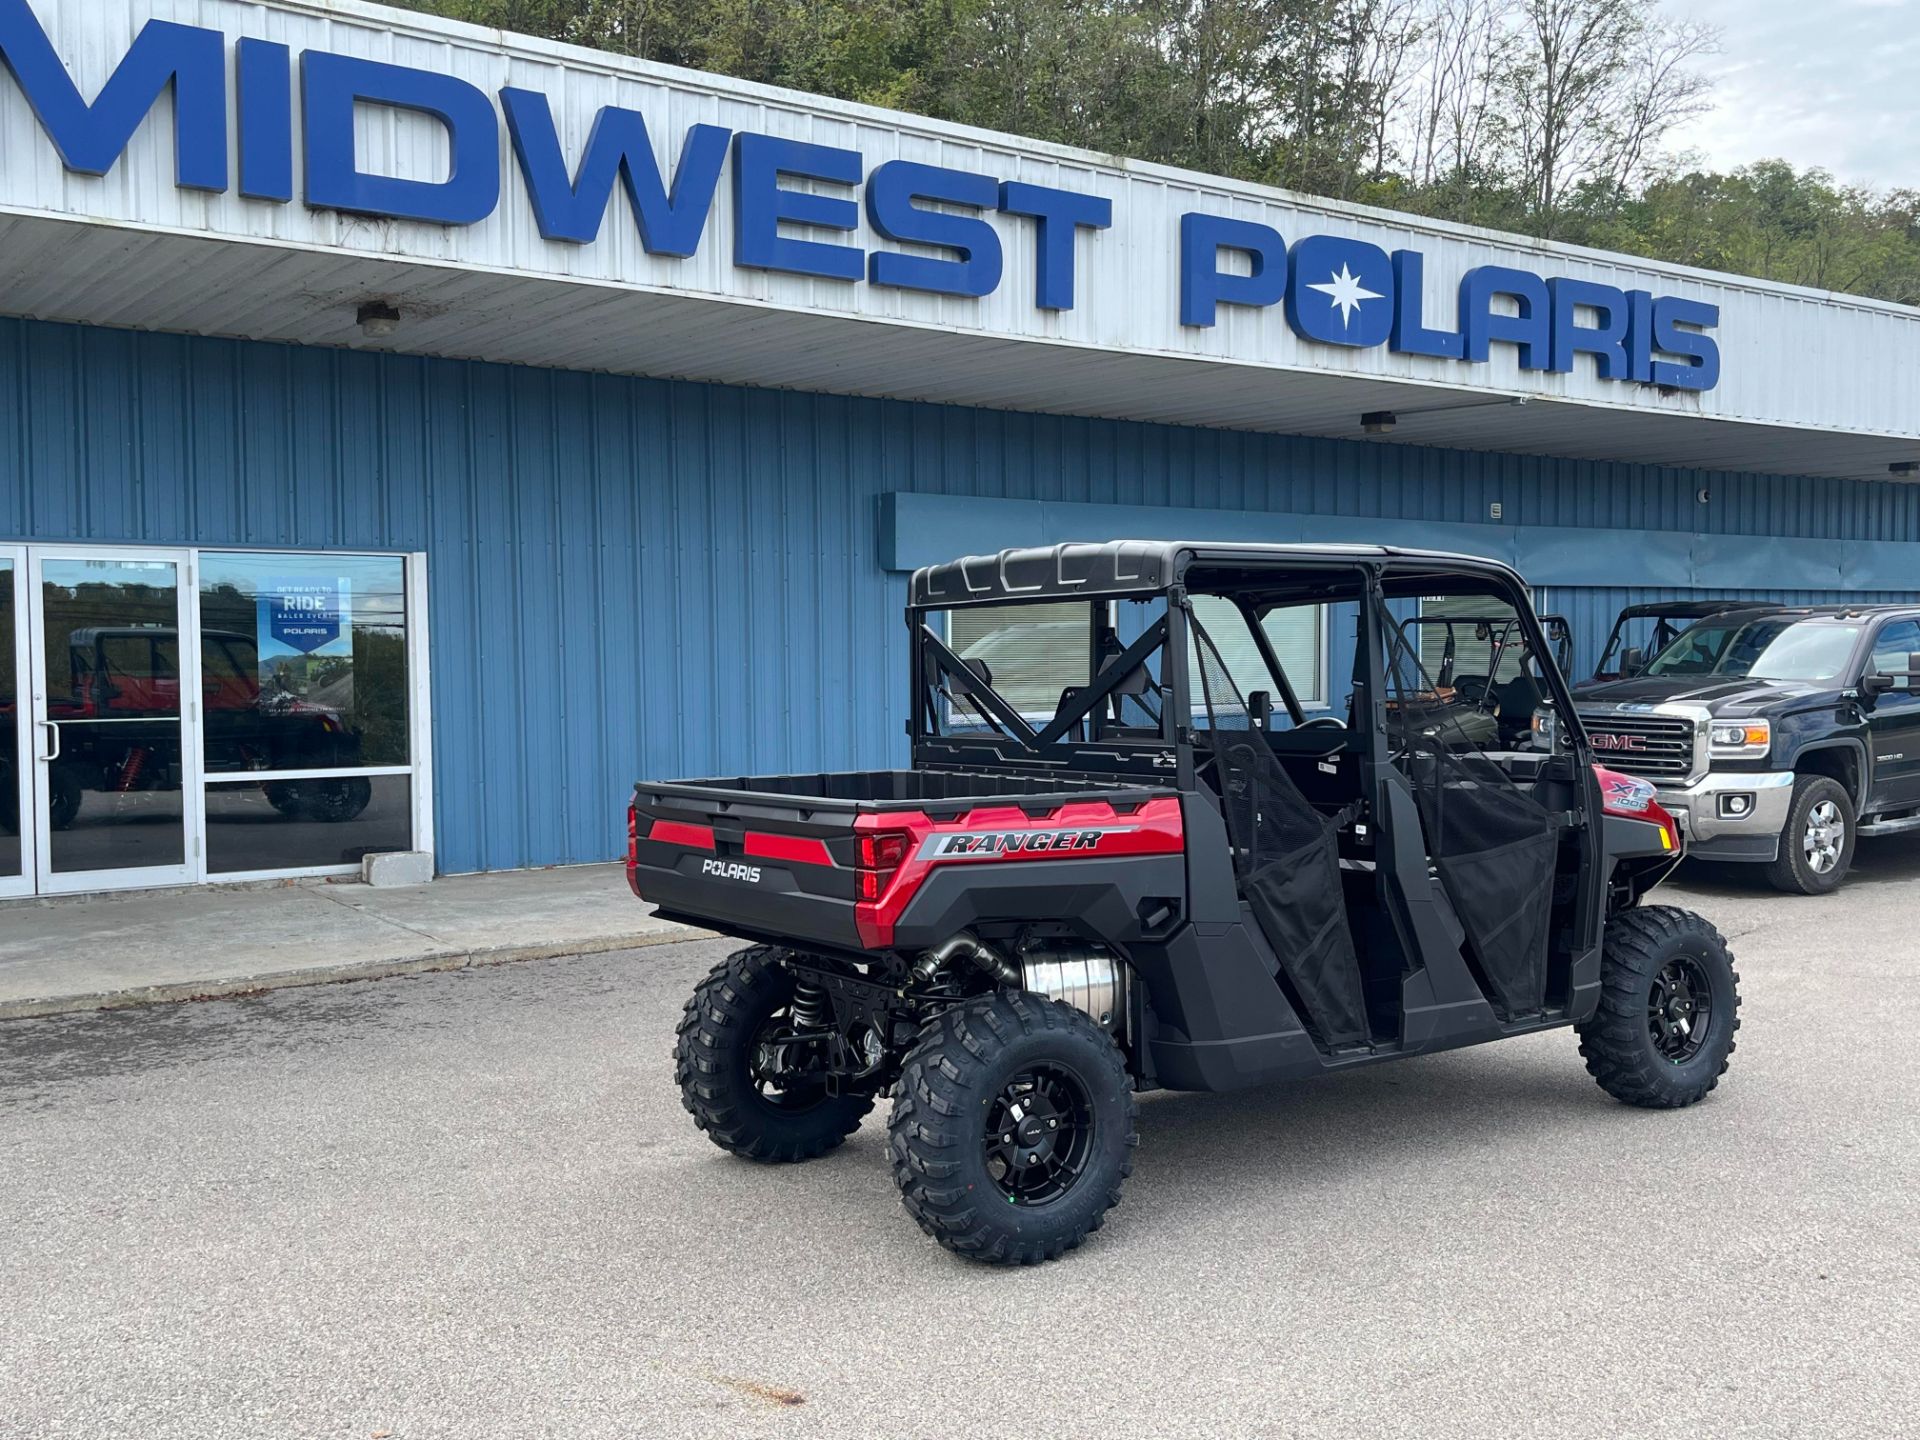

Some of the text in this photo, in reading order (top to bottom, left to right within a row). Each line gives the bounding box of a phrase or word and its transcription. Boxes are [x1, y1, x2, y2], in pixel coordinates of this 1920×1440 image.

[0, 0, 1720, 391] MIDWEST POLARIS
[283, 595, 326, 611] RIDE
[283, 627, 328, 635] POLARIS
[1589, 733, 1646, 752] GMC
[1617, 797, 1648, 809] 1000
[942, 831, 1103, 855] RANGER
[702, 858, 761, 883] POLARIS
